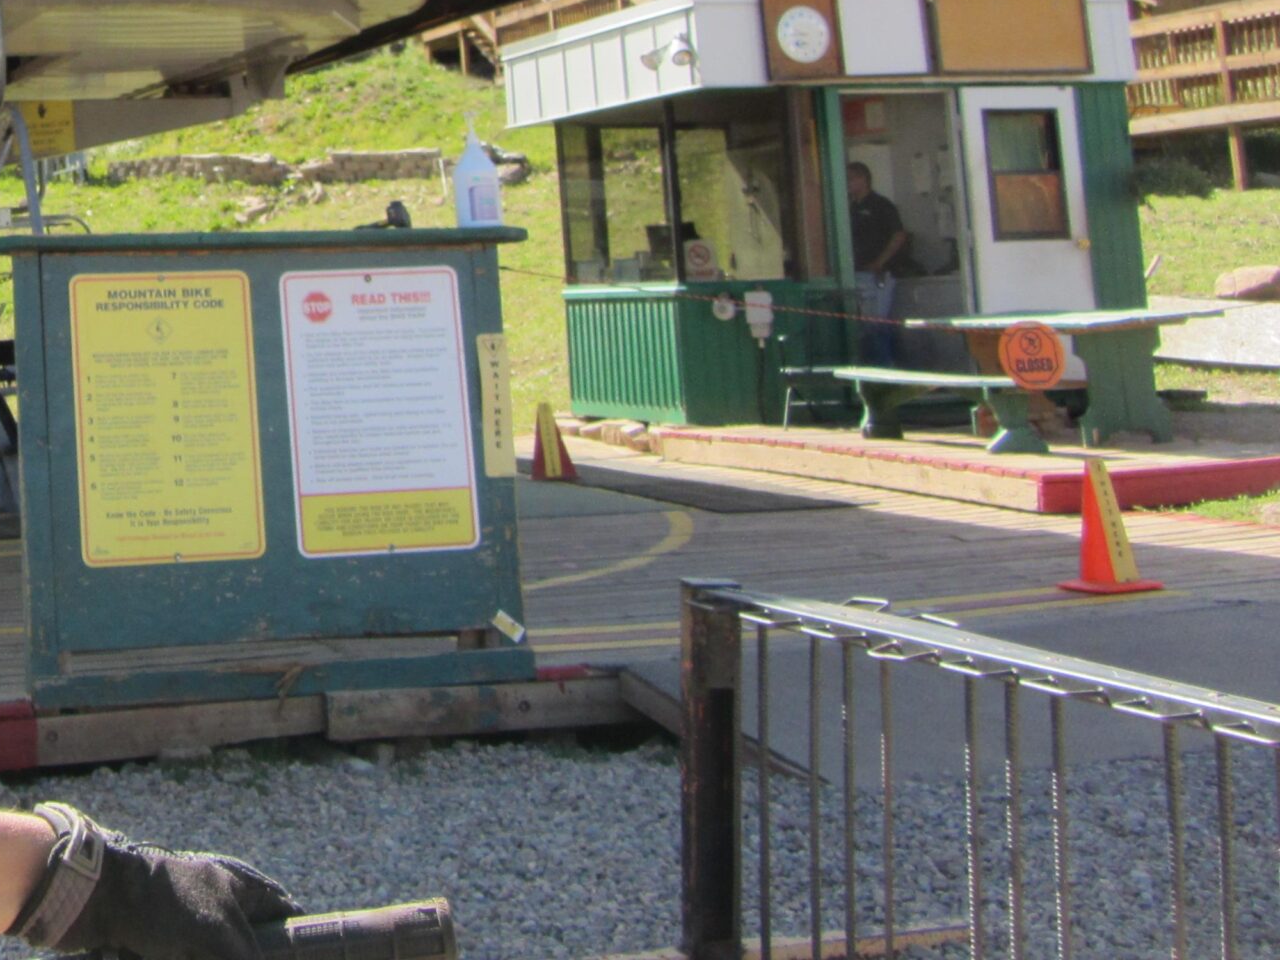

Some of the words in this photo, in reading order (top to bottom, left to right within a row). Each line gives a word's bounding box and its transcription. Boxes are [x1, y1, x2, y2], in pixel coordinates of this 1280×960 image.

[107, 288, 177, 300] MOUNTAIN
[182, 287, 213, 298] BIKE
[350, 293, 387, 306] READ
[95, 300, 189, 312] RESPONSIBILITY
[193, 299, 225, 309] CODE
[303, 301, 333, 315] STOP
[1015, 357, 1054, 372] CLOSED
[489, 360, 500, 402] WAIT
[493, 406, 503, 450] HERE
